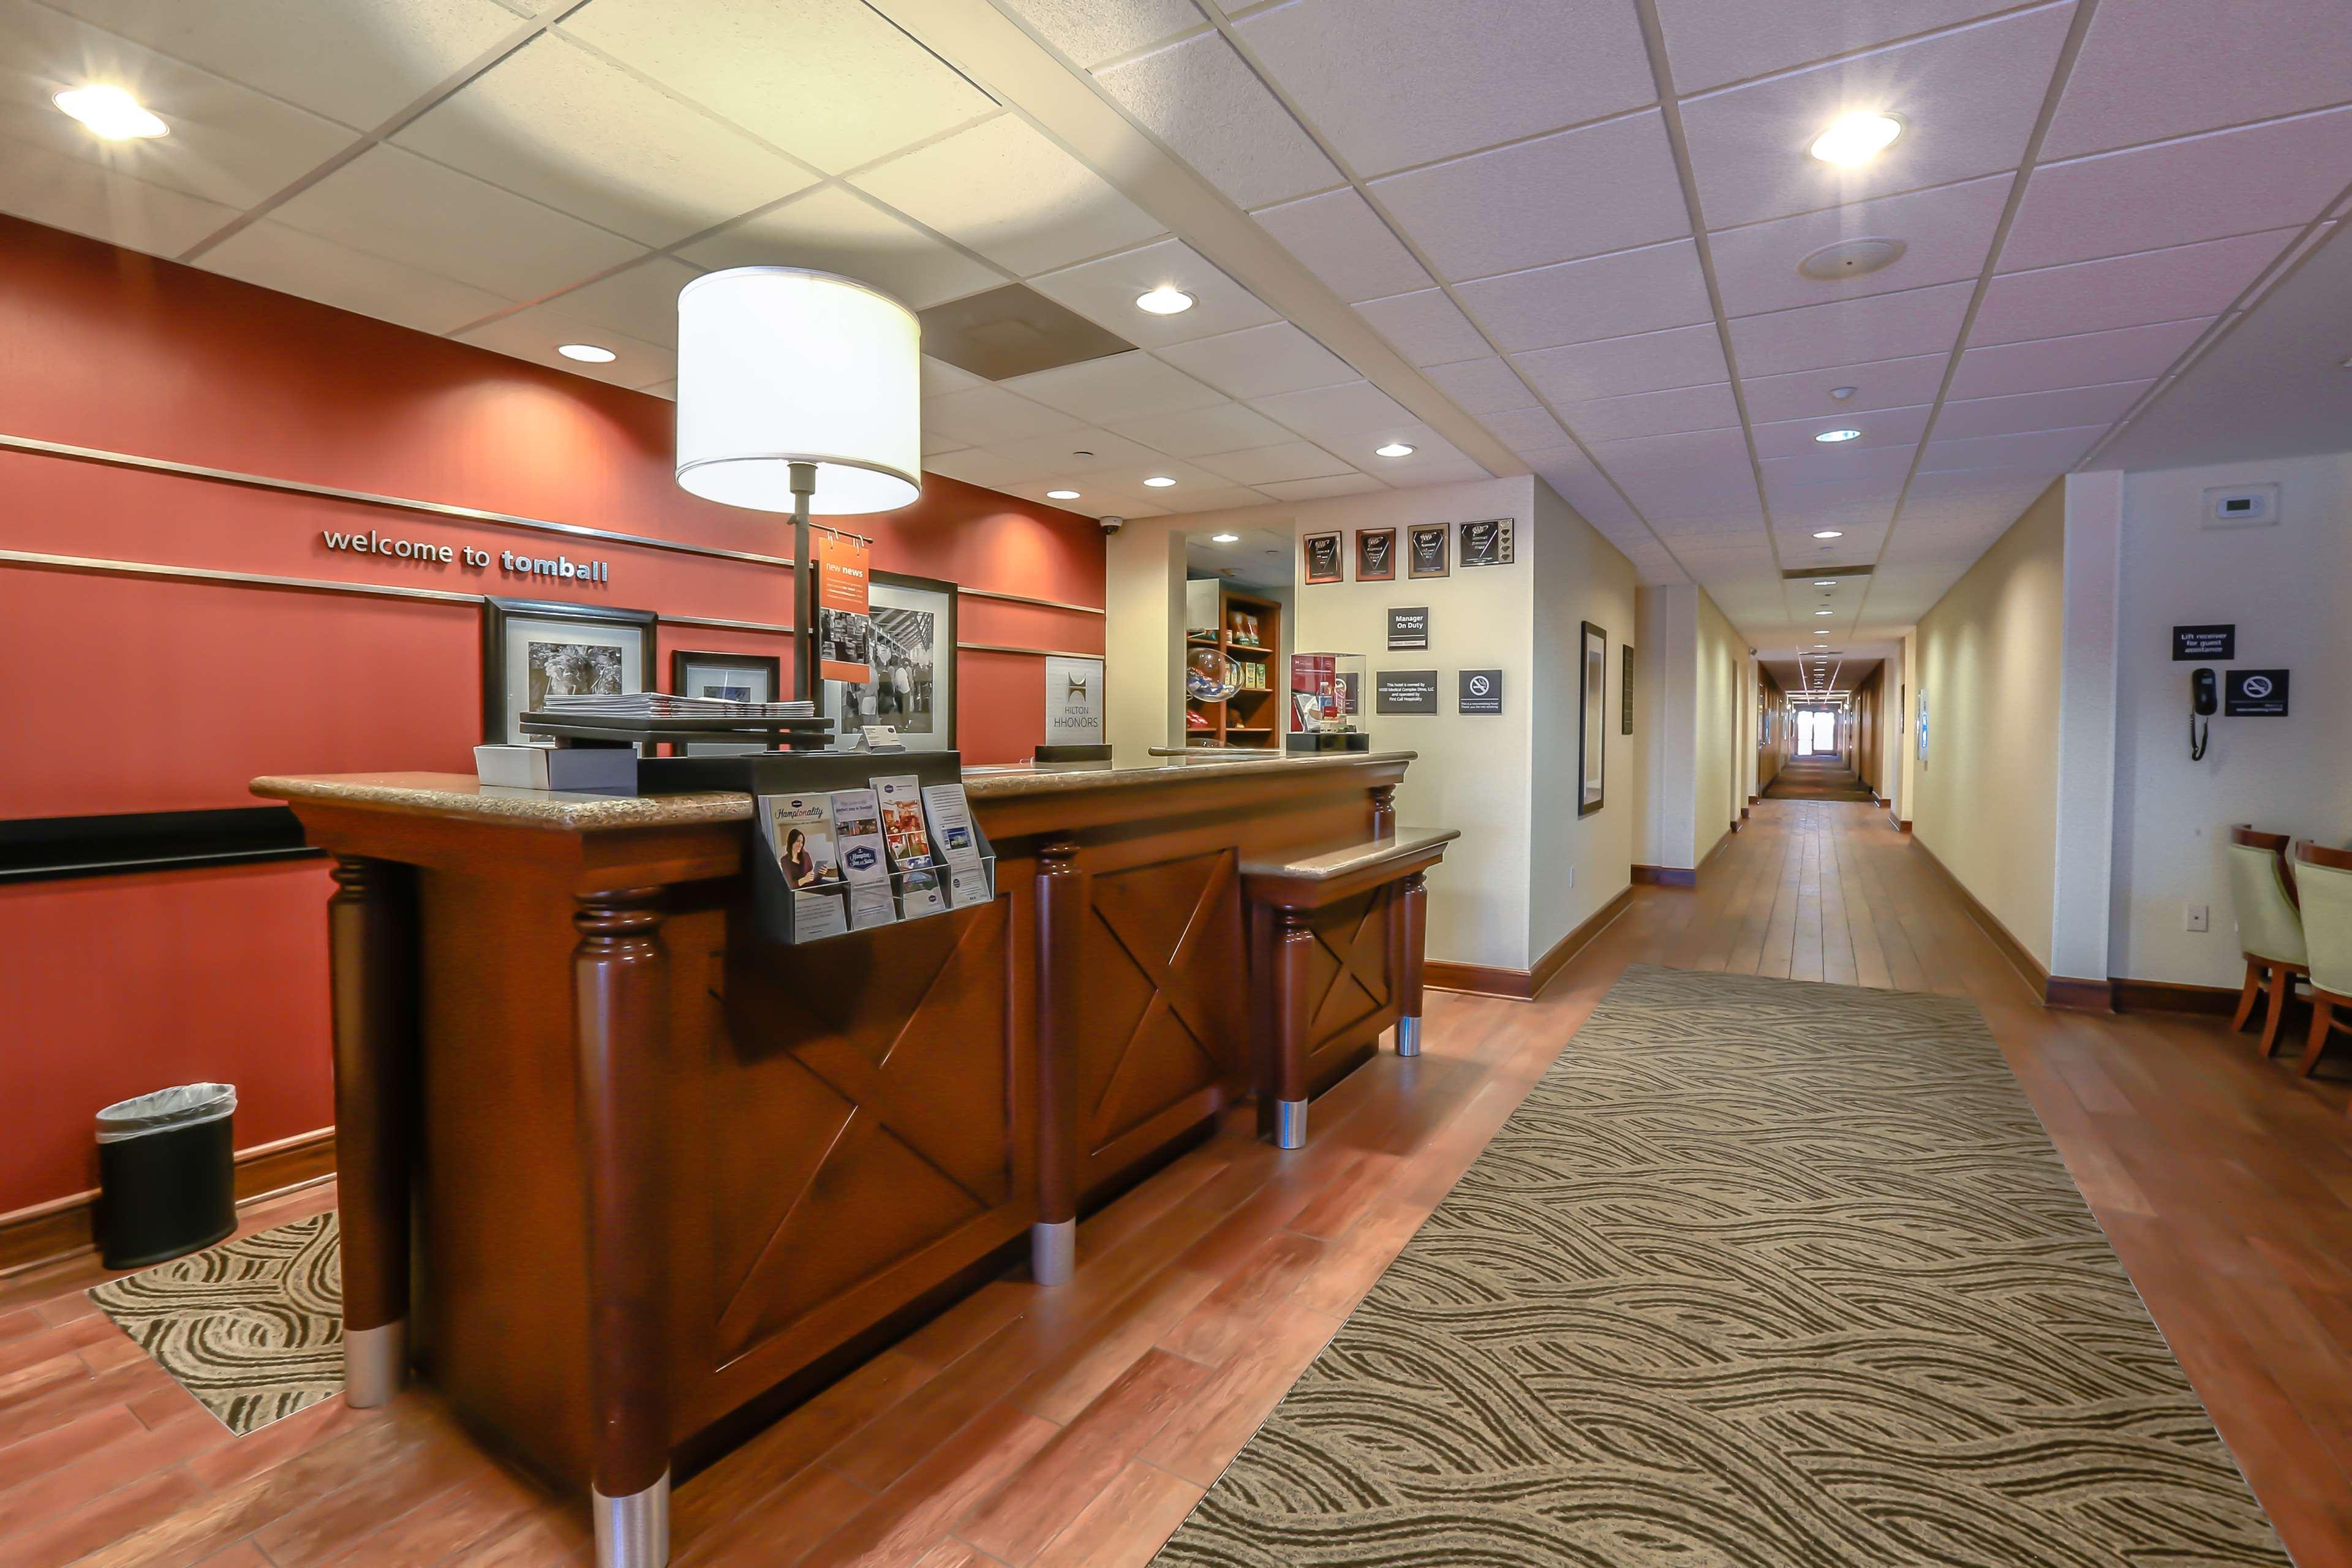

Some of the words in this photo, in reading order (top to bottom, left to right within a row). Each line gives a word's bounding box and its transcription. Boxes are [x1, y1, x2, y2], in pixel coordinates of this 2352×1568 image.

[323, 530, 454, 563] welcome
[463, 545, 491, 567] to
[501, 549, 608, 582] tomball
[826, 563, 841, 572] new
[842, 567, 863, 578] news
[1065, 706, 1089, 715] HILTON
[1054, 717, 1098, 728] HHONORS
[775, 807, 823, 819] Hamptonality
